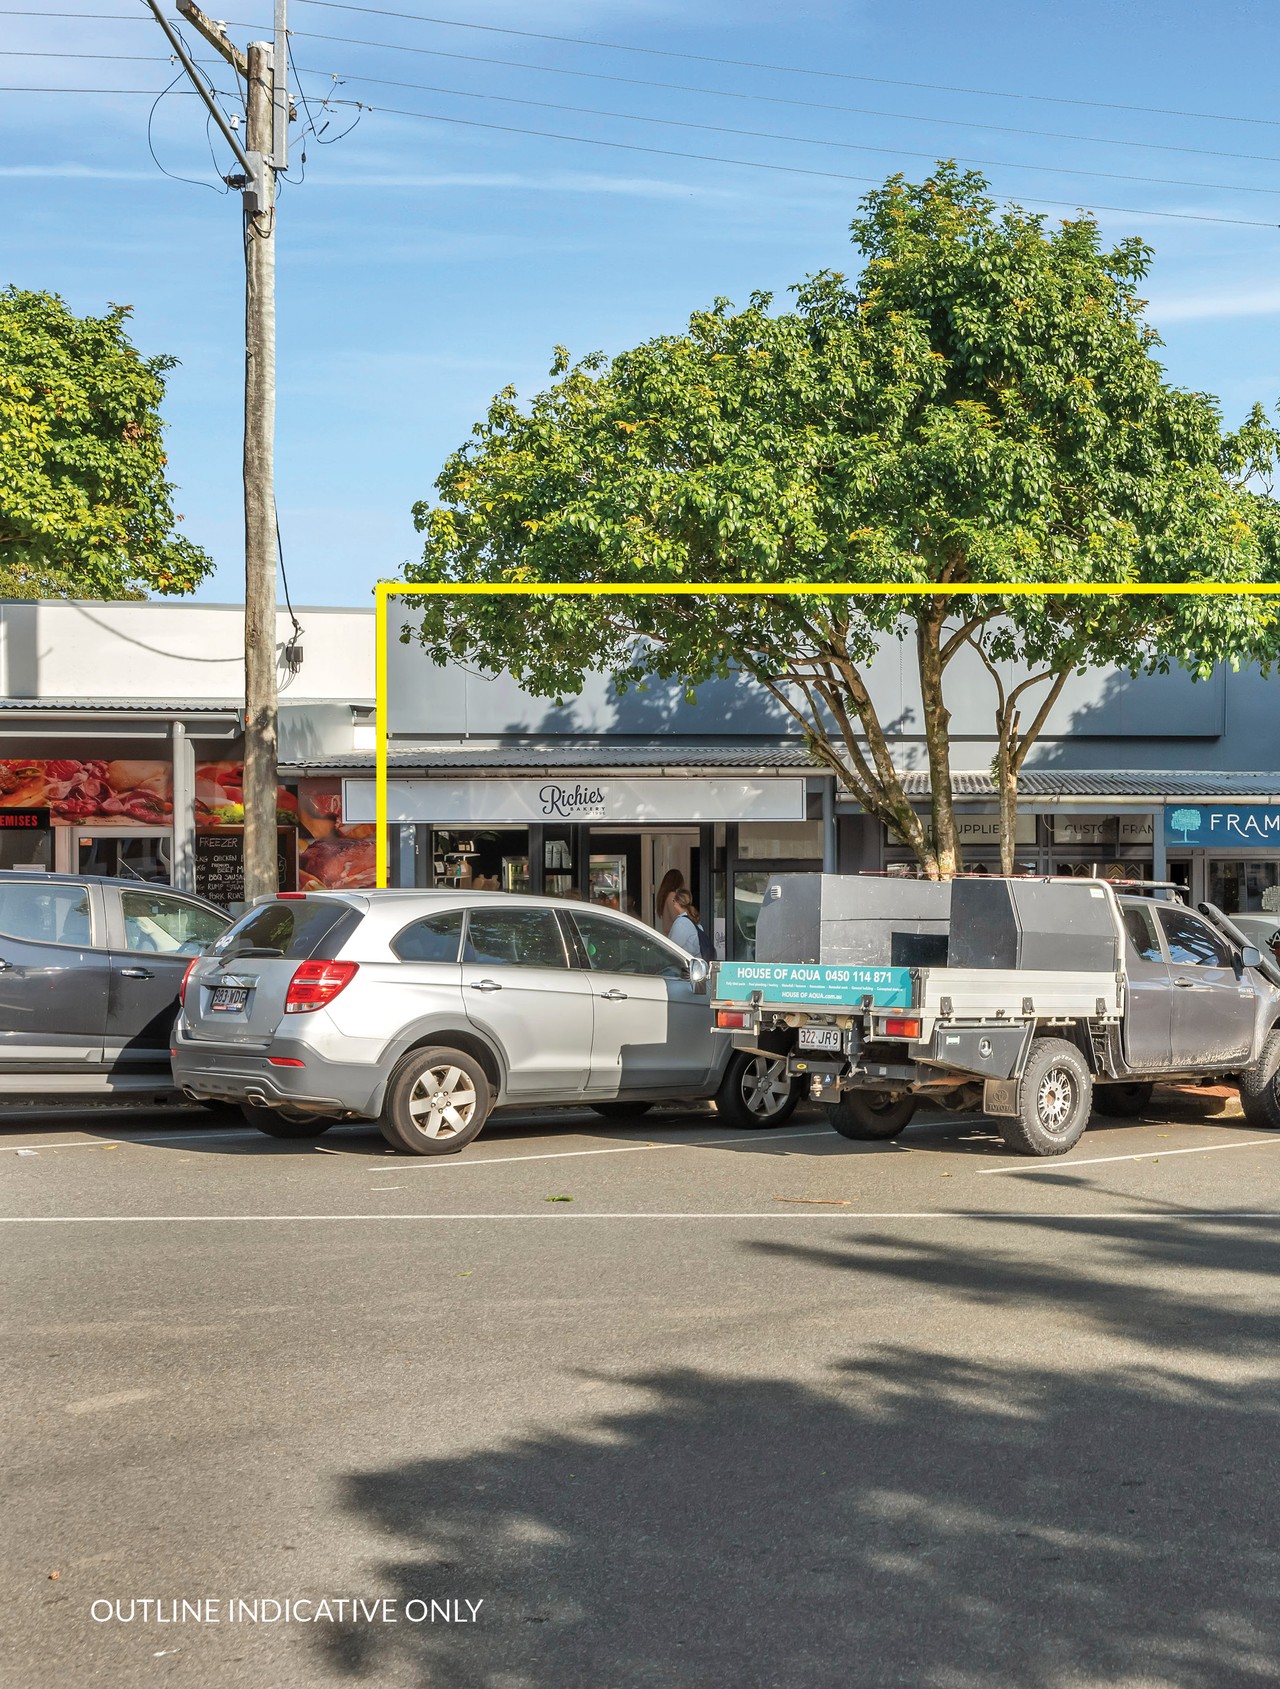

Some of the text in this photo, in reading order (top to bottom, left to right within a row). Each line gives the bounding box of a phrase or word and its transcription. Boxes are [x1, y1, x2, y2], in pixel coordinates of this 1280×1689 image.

[540, 785, 605, 817] Richies
[200, 837, 238, 847] FREEZER
[737, 967, 892, 983] HOUSE OF AQUA 0450 114 871
